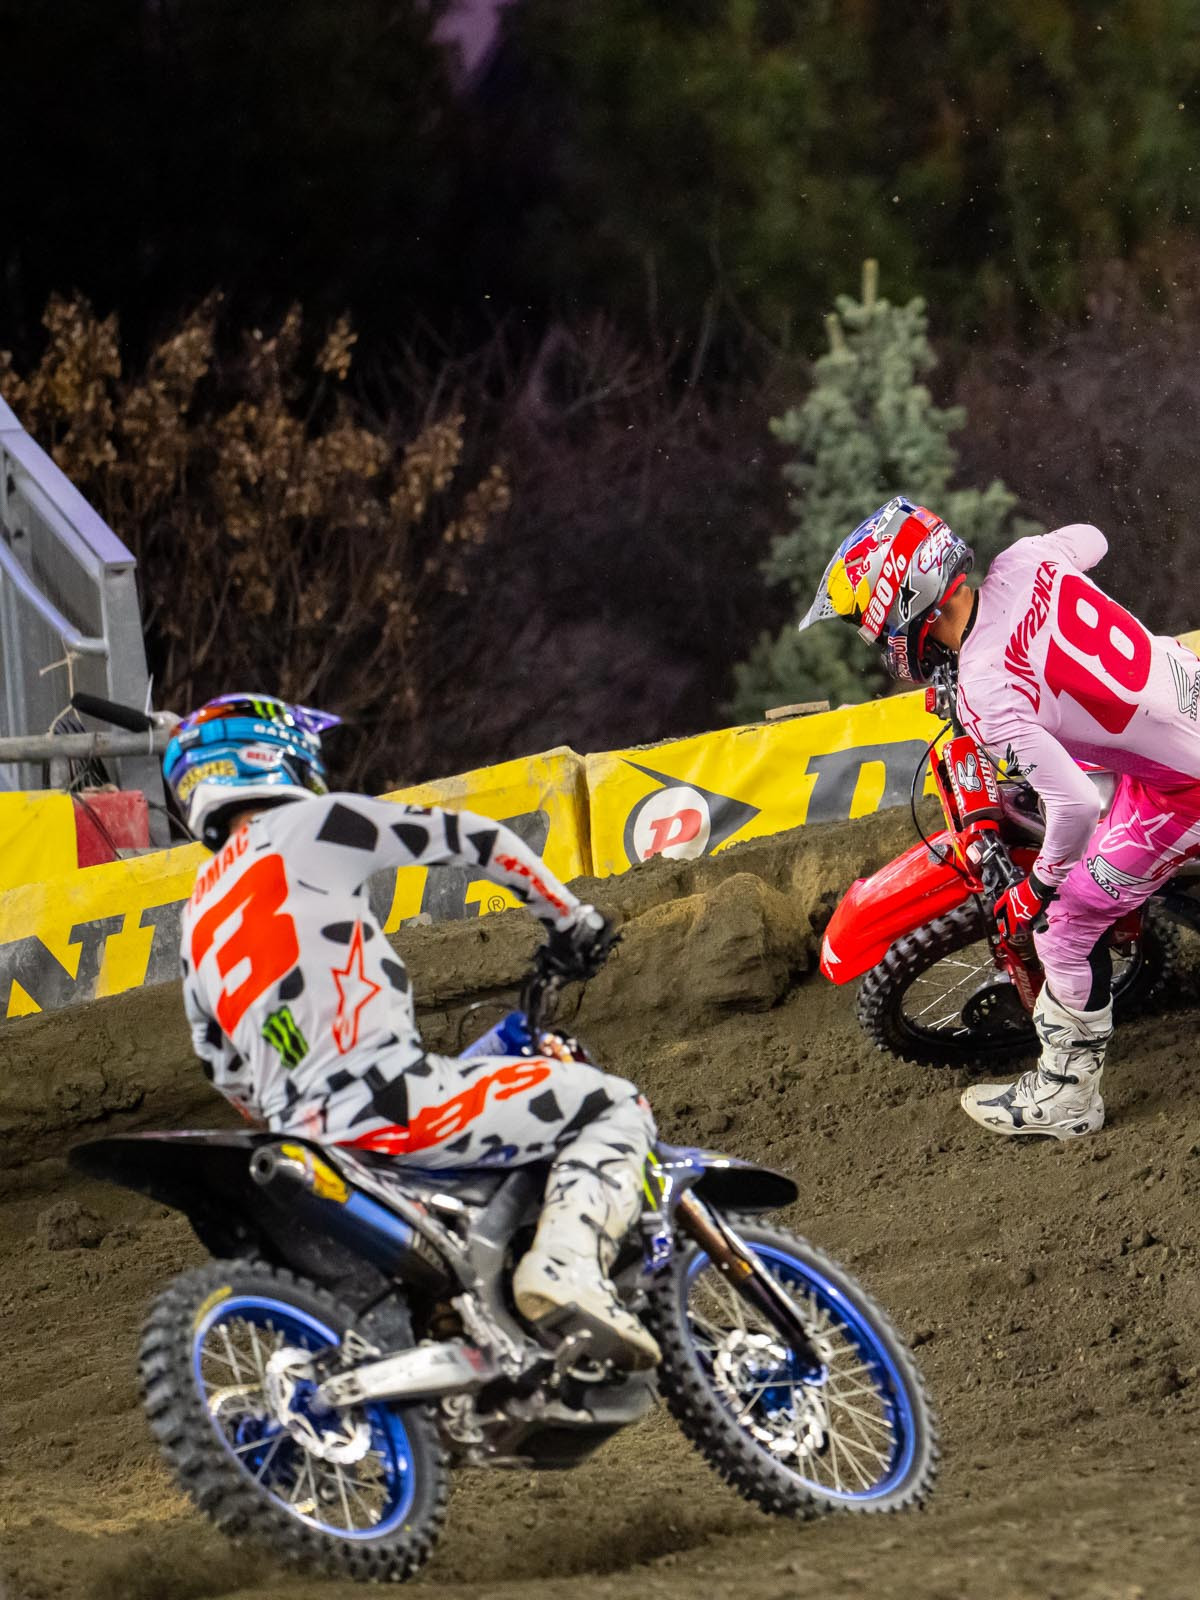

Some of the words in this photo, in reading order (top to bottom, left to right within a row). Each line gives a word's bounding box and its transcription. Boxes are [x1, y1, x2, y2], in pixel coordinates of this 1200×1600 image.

[864, 548, 907, 633] 100%
[1044, 574, 1152, 734] 18
[1087, 857, 1120, 900] HONDA
[191, 853, 300, 1035] 3
